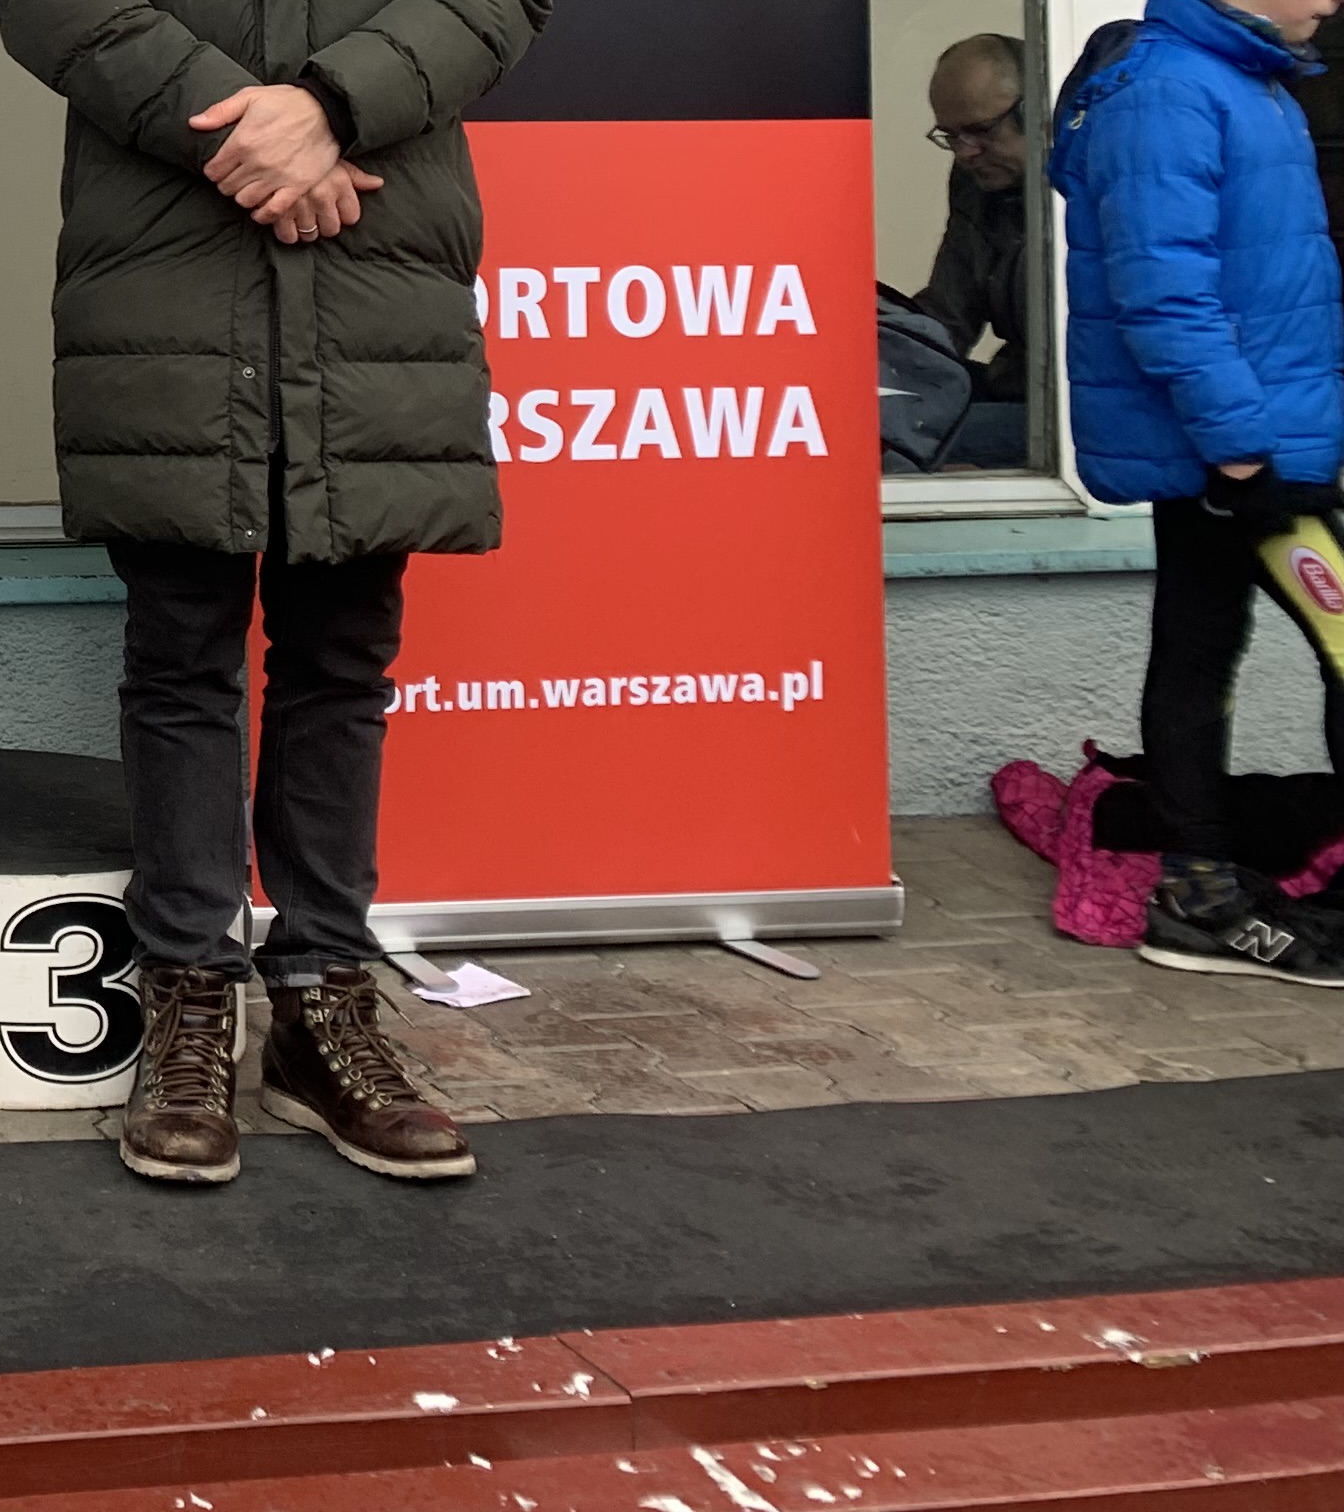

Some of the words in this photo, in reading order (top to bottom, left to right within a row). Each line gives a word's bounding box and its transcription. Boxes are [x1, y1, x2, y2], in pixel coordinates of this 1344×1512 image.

[474, 264, 818, 340] RTOWA
[488, 386, 829, 464] RSZAWA
[384, 660, 824, 714] rt.um.warszawa.pl
